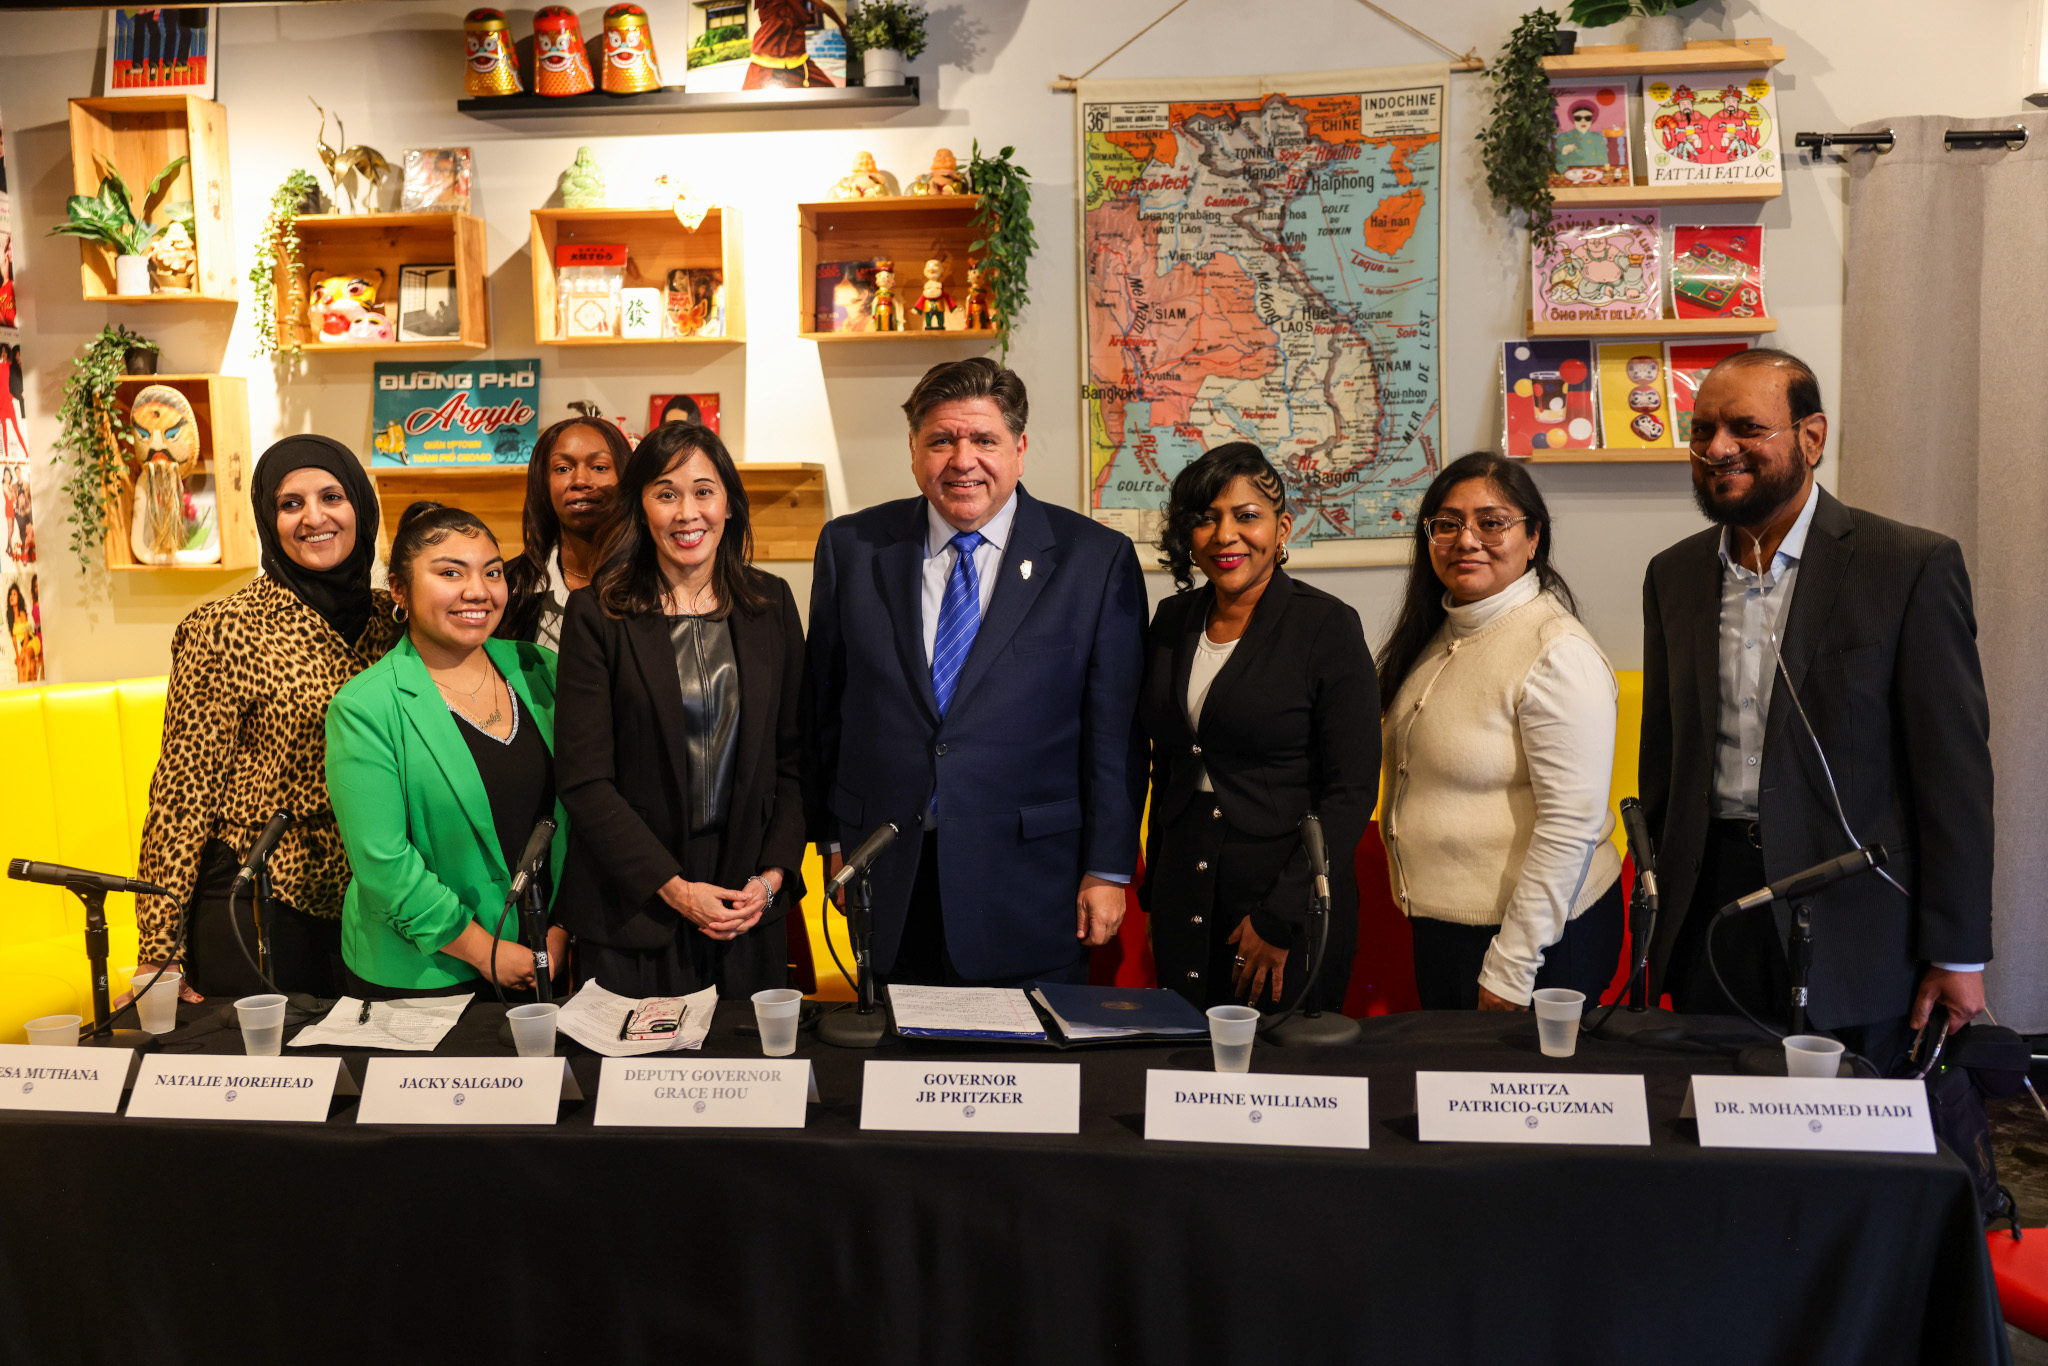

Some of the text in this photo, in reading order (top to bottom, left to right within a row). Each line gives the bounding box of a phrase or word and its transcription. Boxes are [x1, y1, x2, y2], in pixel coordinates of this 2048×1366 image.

[1365, 93, 1436, 110] INDOCHINE
[1322, 119, 1360, 132] CHINE
[1235, 148, 1274, 160] TONKIN
[1160, 174, 1190, 190] Teck
[1322, 204, 1350, 214] GOLFE
[1181, 225, 1202, 234] LAOS
[1317, 227, 1352, 236] TONKIN
[1285, 232, 1308, 242] Vinh
[1156, 308, 1186, 320] SIAM
[1354, 310, 1393, 320] Tourane
[1280, 320, 1314, 333] LAOS
[1396, 327, 1418, 338] Soie
[1370, 360, 1412, 373] ANNAM
[1082, 384, 1137, 404] Bangkok
[1402, 411, 1423, 445] MER
[1418, 362, 1430, 383] DE
[404, 390, 536, 434] Argyle
[1117, 481, 1154, 492] GOLFE
[24, 1067, 99, 1081] MUTHANA
[624, 1069, 782, 1082] DEPUTY GOVERNOR
[923, 1073, 1017, 1086] GOVERNOR
[155, 1074, 314, 1089] NATALIE MOREHEAD
[399, 1076, 524, 1089] JACKY SALGADO
[654, 1087, 749, 1100] GRACE HOU
[1490, 1083, 1569, 1096] MARITZA
[915, 1091, 1023, 1104] JB PRITZKER
[1175, 1091, 1338, 1109] DAPHNE WILLIAMS
[1449, 1100, 1614, 1114] PATRICIO-GUZMAN
[1714, 1101, 1913, 1118] DR. MOHAMMED HADI
